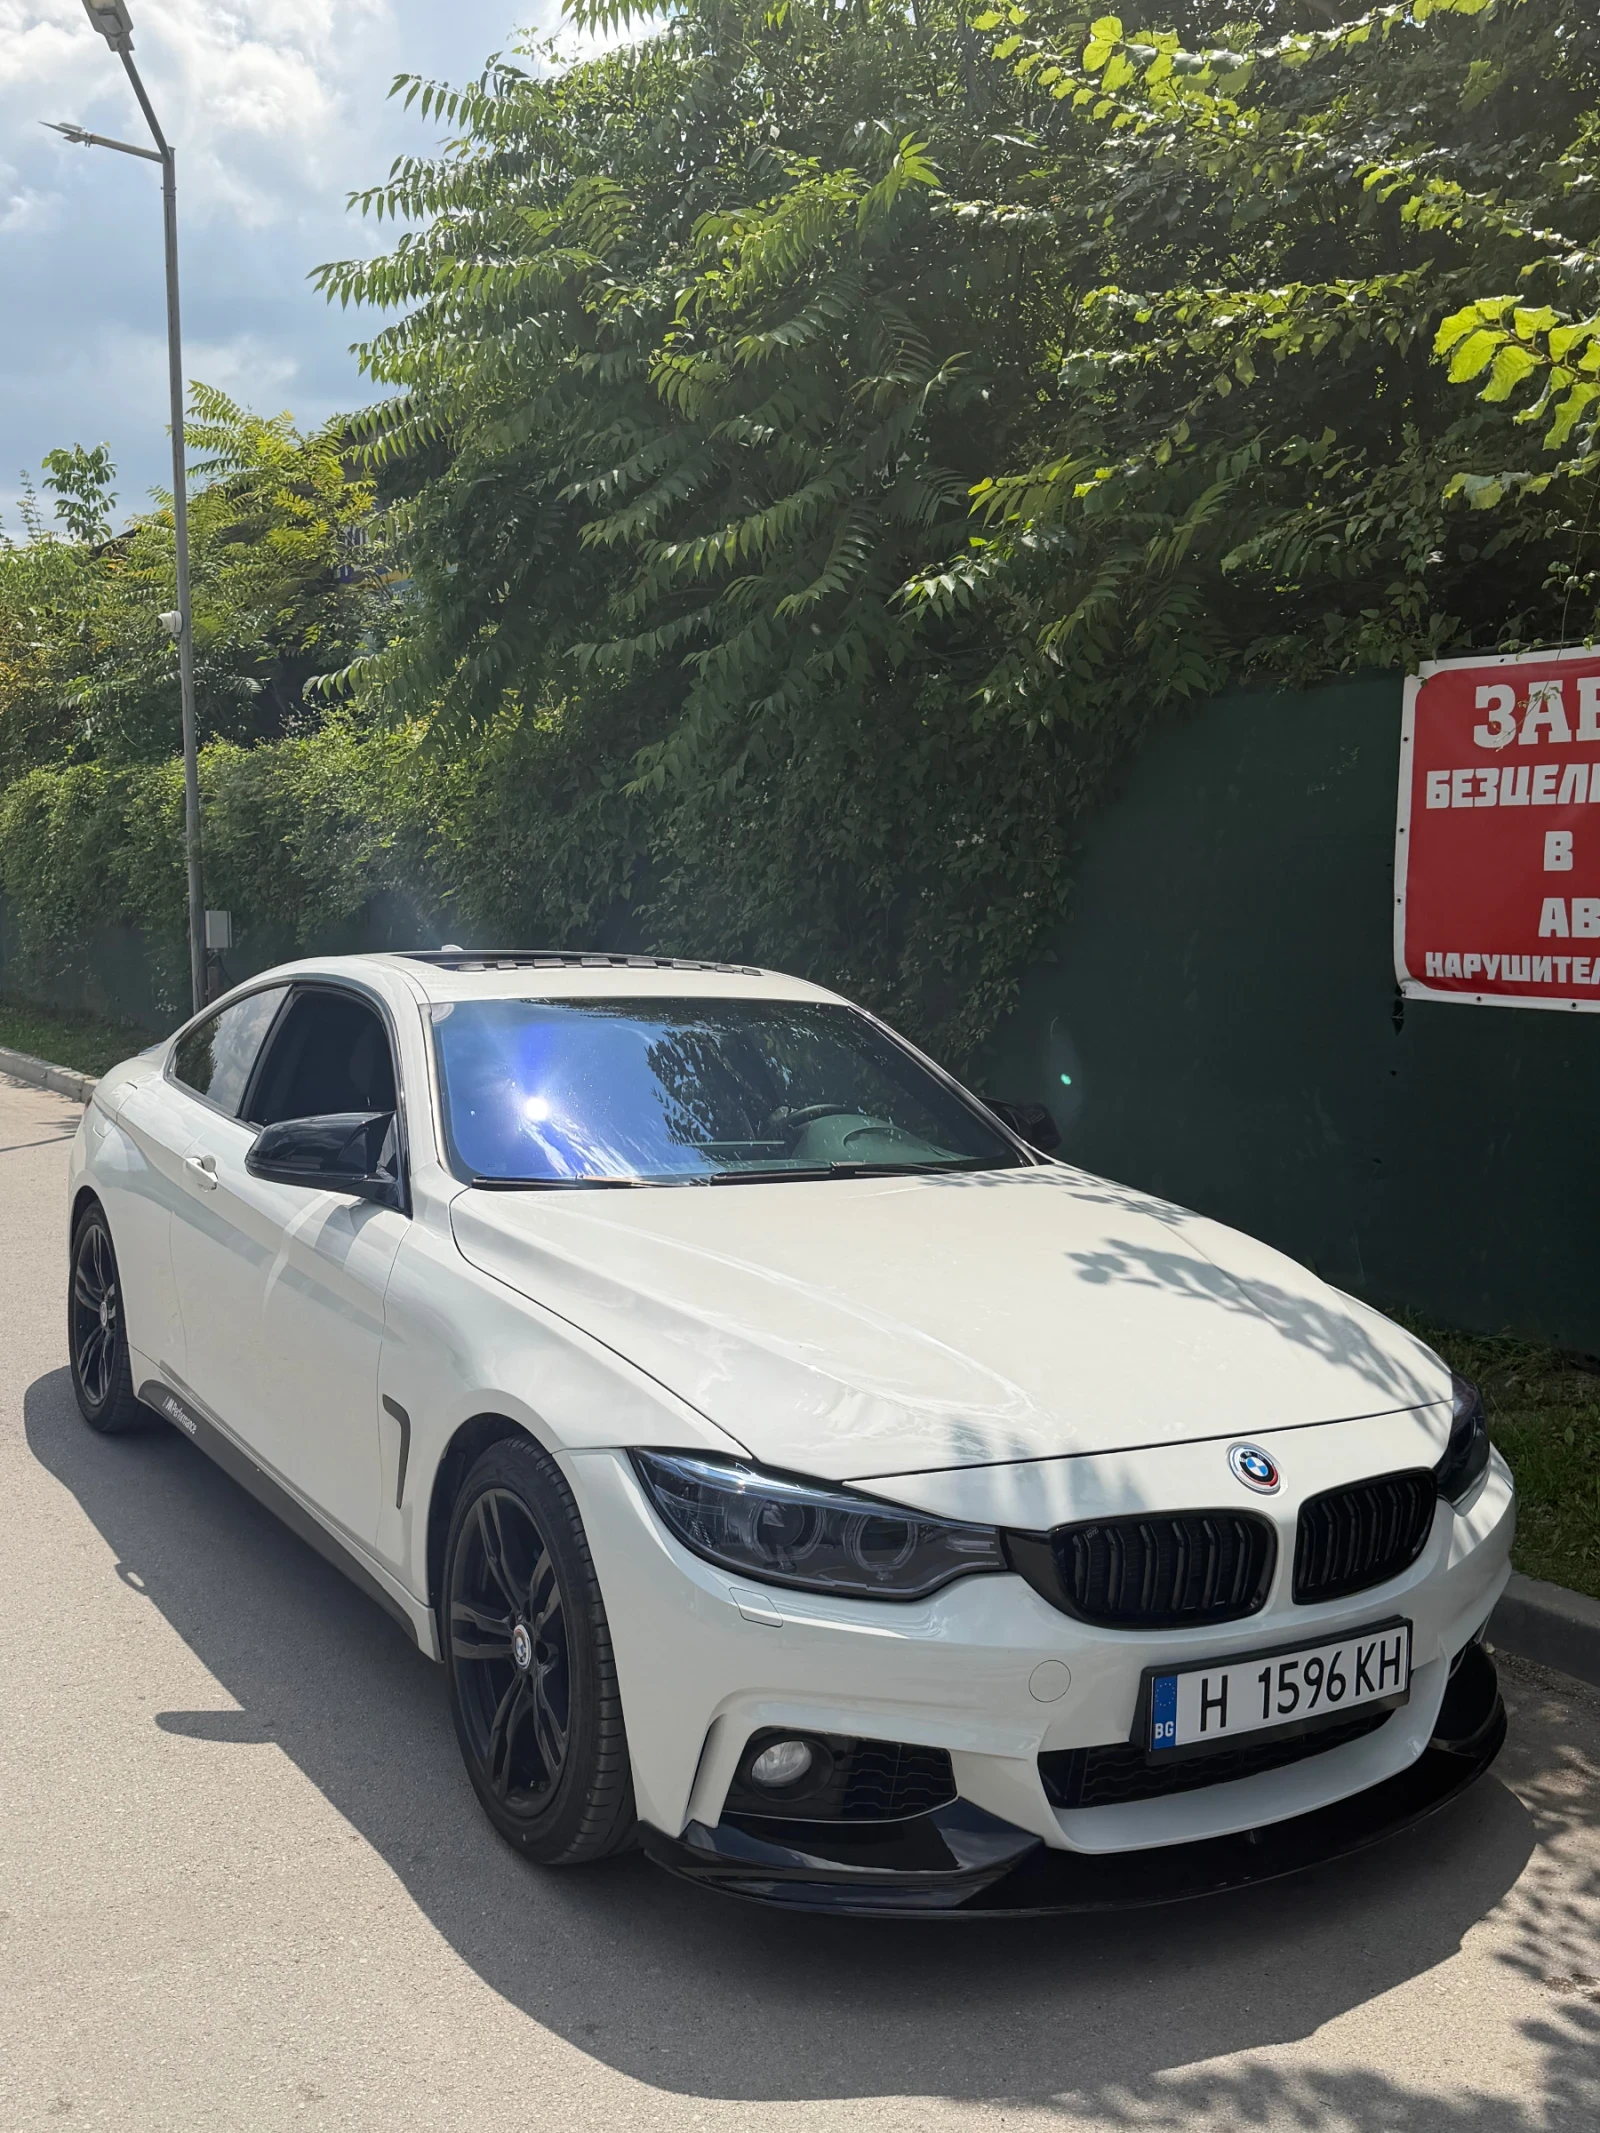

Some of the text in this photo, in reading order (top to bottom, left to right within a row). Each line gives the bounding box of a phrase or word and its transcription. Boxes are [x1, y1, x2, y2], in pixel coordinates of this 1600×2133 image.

[1543, 830, 1573, 872] В
[1538, 897, 1600, 938] АВ
[1199, 1635, 1402, 1732] H 1596 KH
[1154, 1721, 1174, 1740] BG
